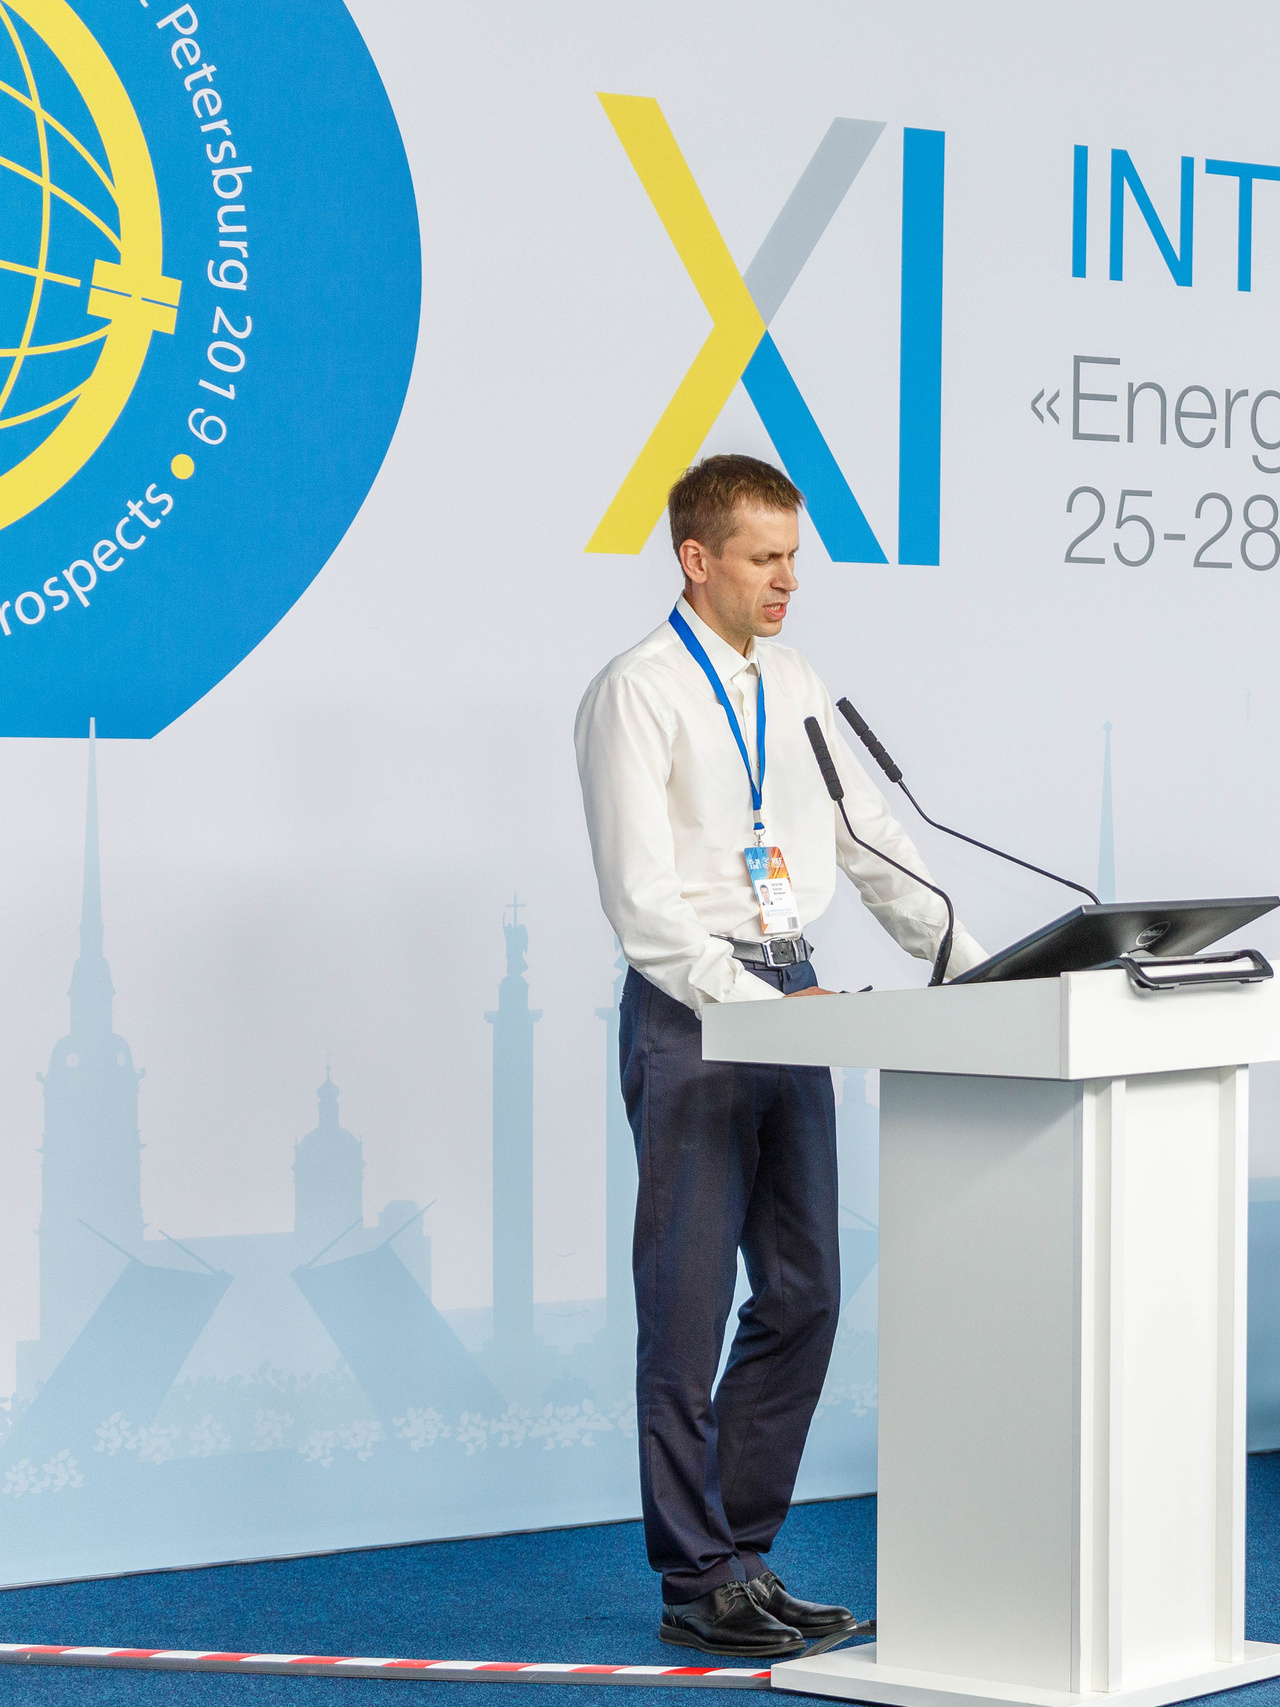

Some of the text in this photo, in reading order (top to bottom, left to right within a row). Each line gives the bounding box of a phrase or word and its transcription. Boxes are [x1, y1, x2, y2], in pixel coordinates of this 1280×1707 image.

[156, 3, 253, 446] Petersburg 2019
[583, 92, 946, 567] XI
[0, 482, 174, 636] rospects
[1063, 485, 1280, 572] 25-28
